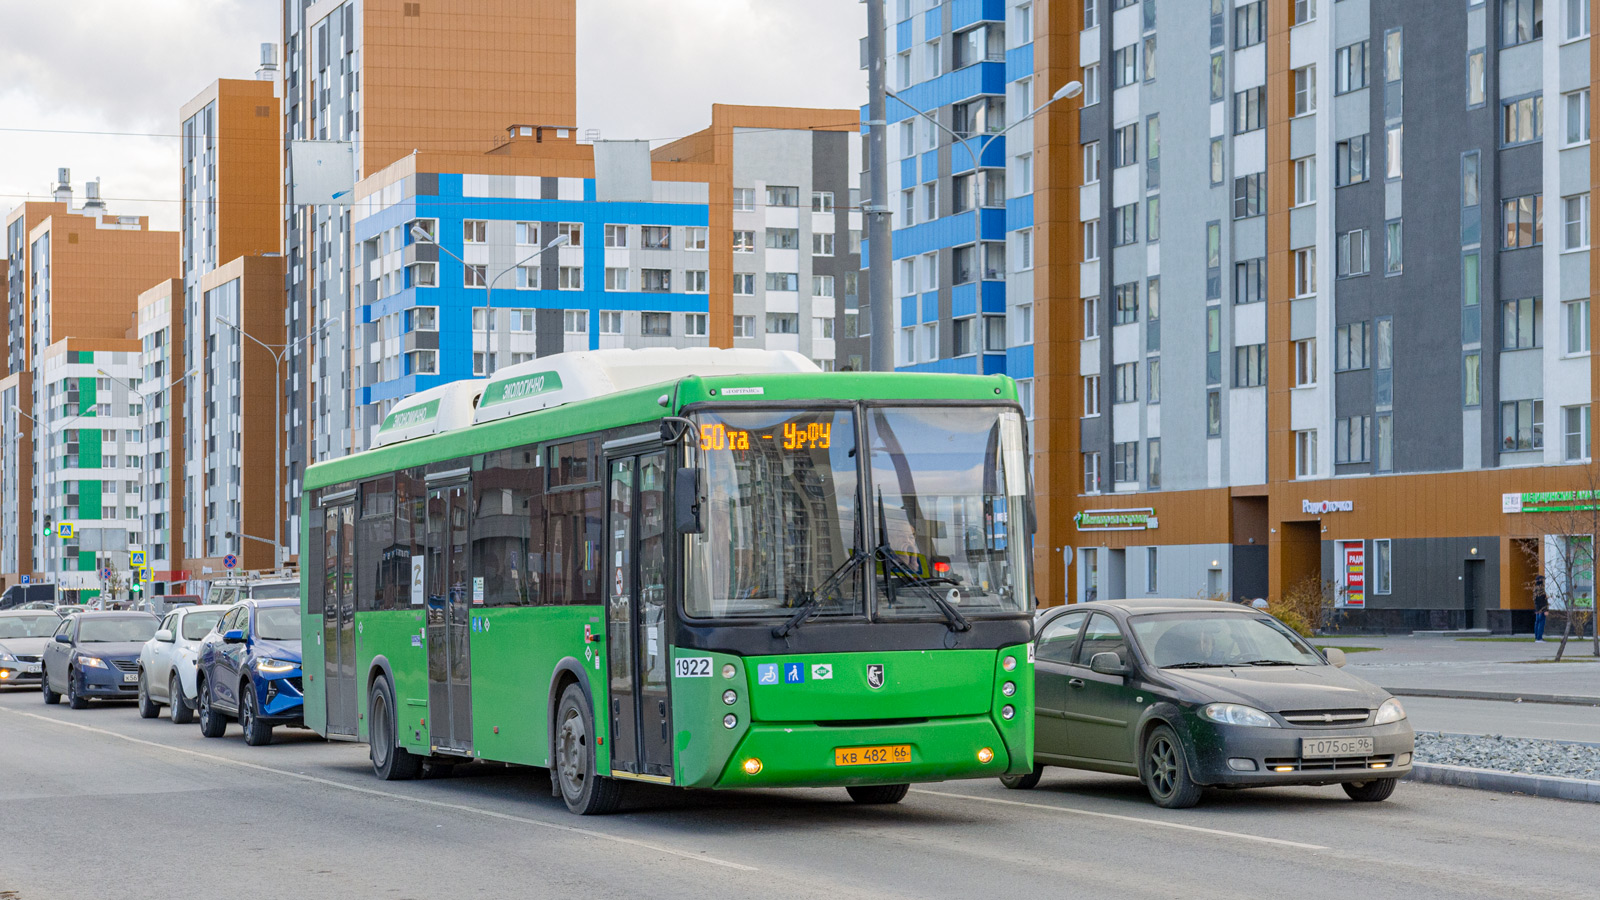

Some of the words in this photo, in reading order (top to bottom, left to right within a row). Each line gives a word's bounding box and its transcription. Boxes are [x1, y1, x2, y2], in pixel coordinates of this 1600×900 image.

[503, 375, 544, 399] ЭКОЛОГИЧНО
[393, 407, 427, 427] ЭКОНОМИЧНО
[700, 424, 749, 450] 50та
[783, 423, 831, 449] УрФУ
[676, 659, 710, 675] 1922
[842, 753, 857, 763] КВ
[864, 749, 887, 762] 482
[894, 747, 906, 757] 66
